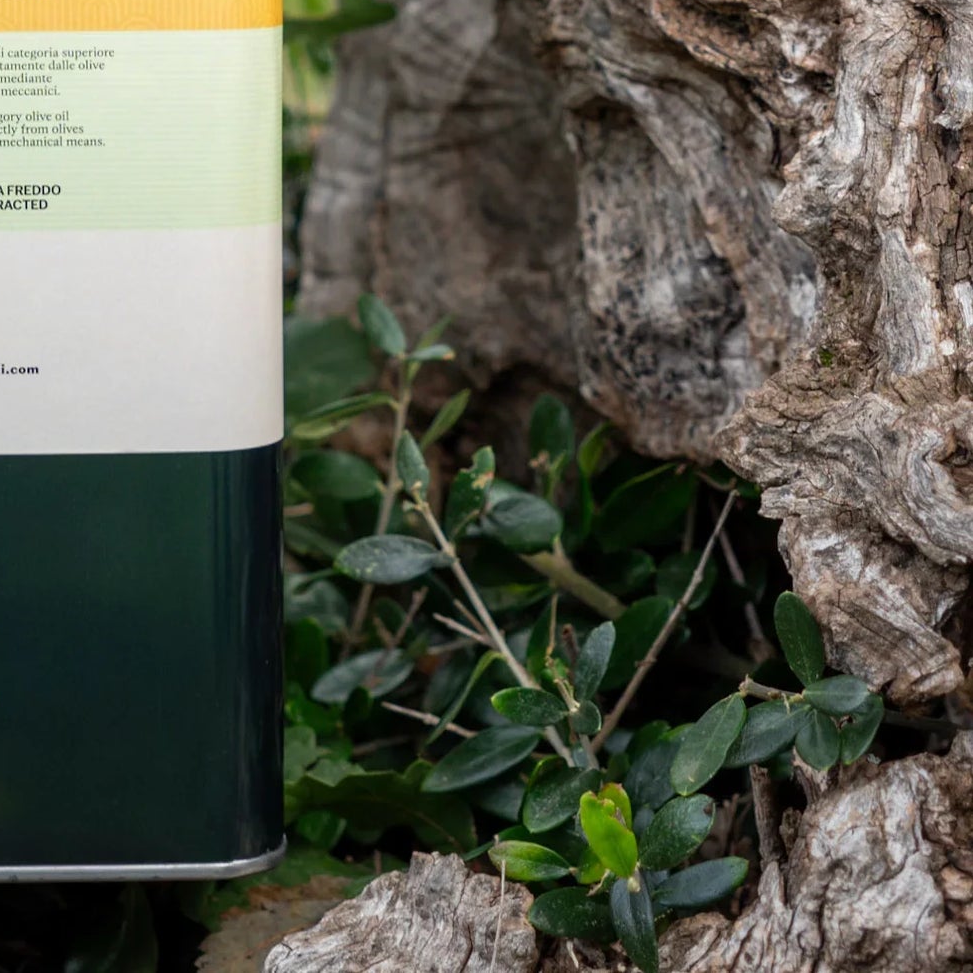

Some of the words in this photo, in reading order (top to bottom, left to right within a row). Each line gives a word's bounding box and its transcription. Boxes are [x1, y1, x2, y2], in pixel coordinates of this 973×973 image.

[8, 47, 59, 61] categoria
[62, 47, 114, 60] superiore
[48, 60, 75, 70] dalle
[78, 60, 105, 70] olive
[0, 73, 52, 83] mediante
[1, 86, 60, 96] meccanici.
[26, 112, 52, 122] olive
[55, 111, 69, 121] oil
[21, 124, 49, 134] from
[52, 124, 84, 134] olives
[0, 137, 63, 147] mechanical
[66, 137, 105, 147] means.
[7, 185, 61, 196] FREDDO
